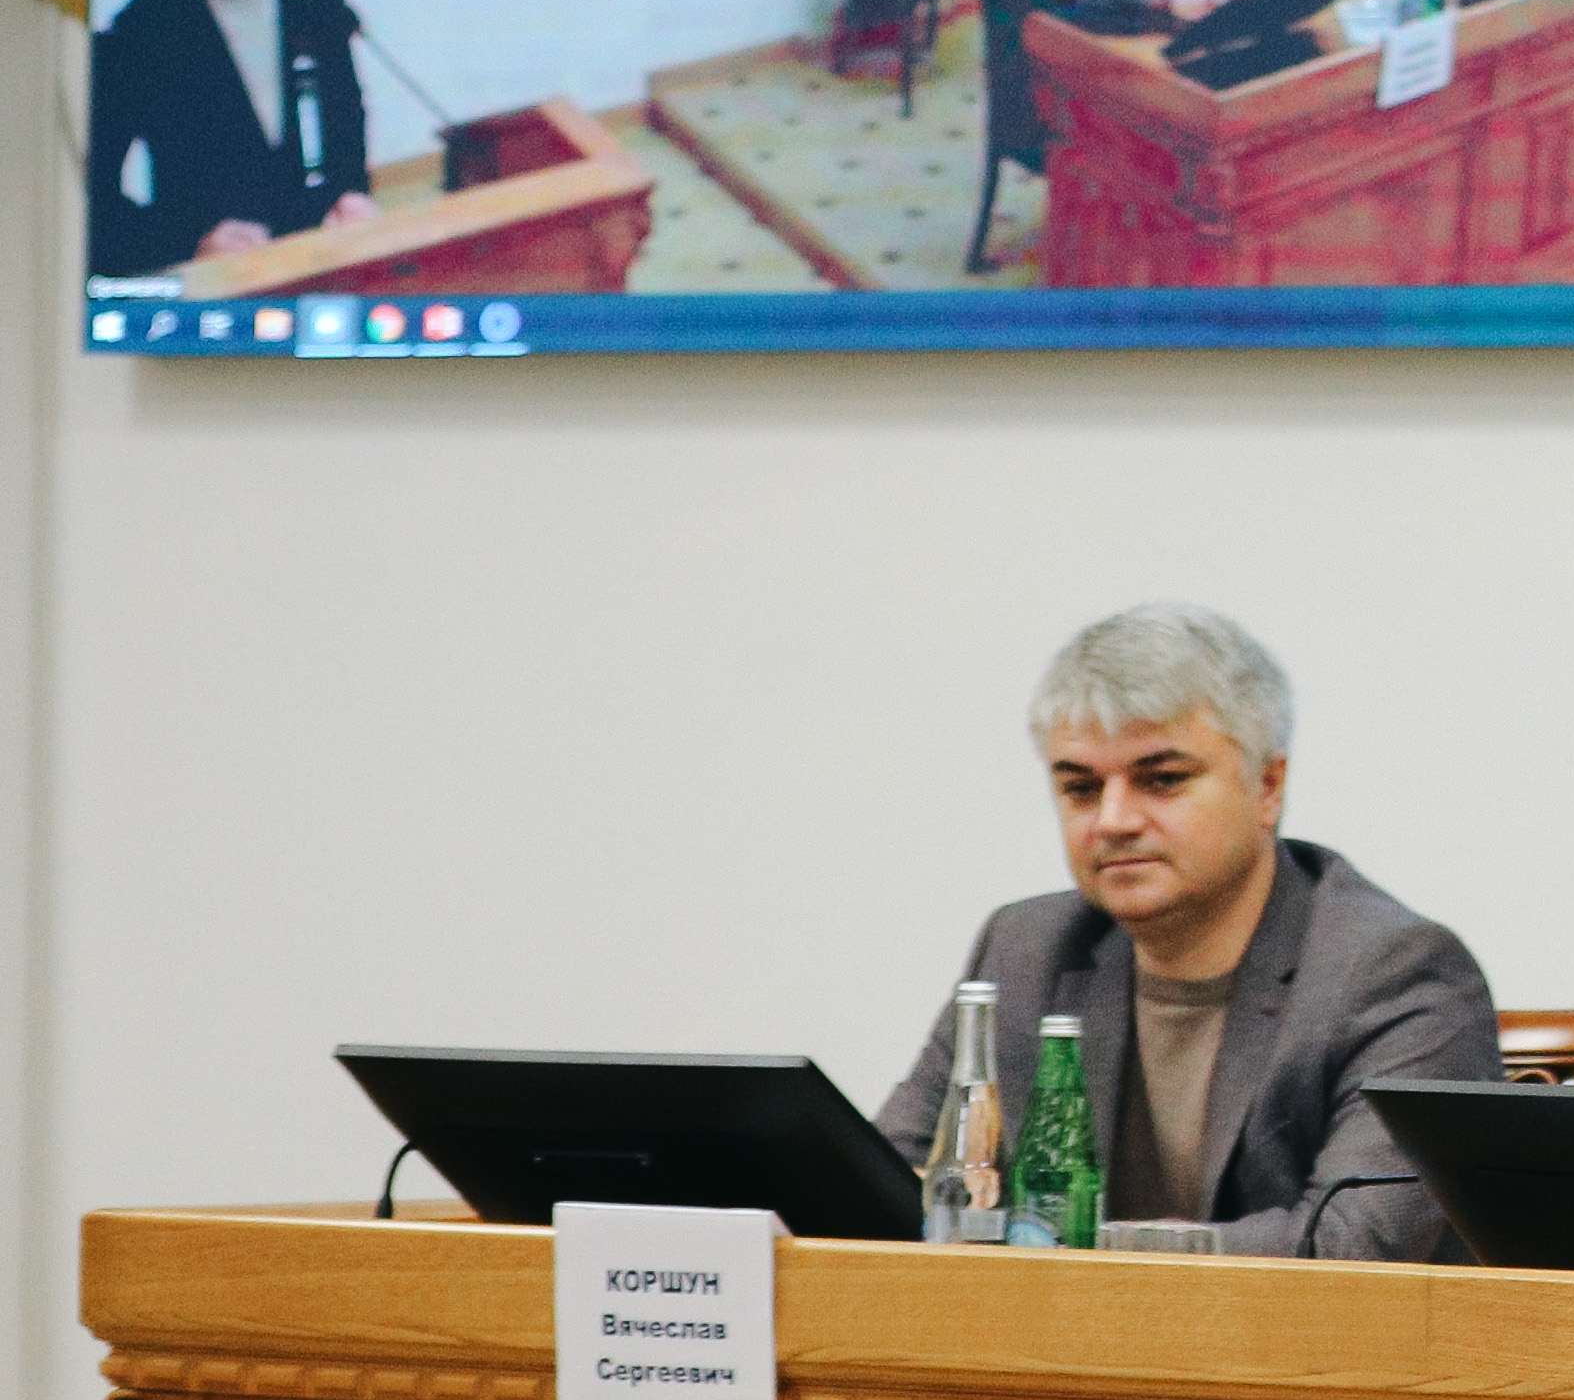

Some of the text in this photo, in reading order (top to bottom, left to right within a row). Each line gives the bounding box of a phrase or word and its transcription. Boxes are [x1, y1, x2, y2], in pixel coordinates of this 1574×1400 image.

[607, 1269, 720, 1294] КОРШУН
[602, 1313, 727, 1339] Вячеслав
[597, 1357, 734, 1386] Сергеевич
